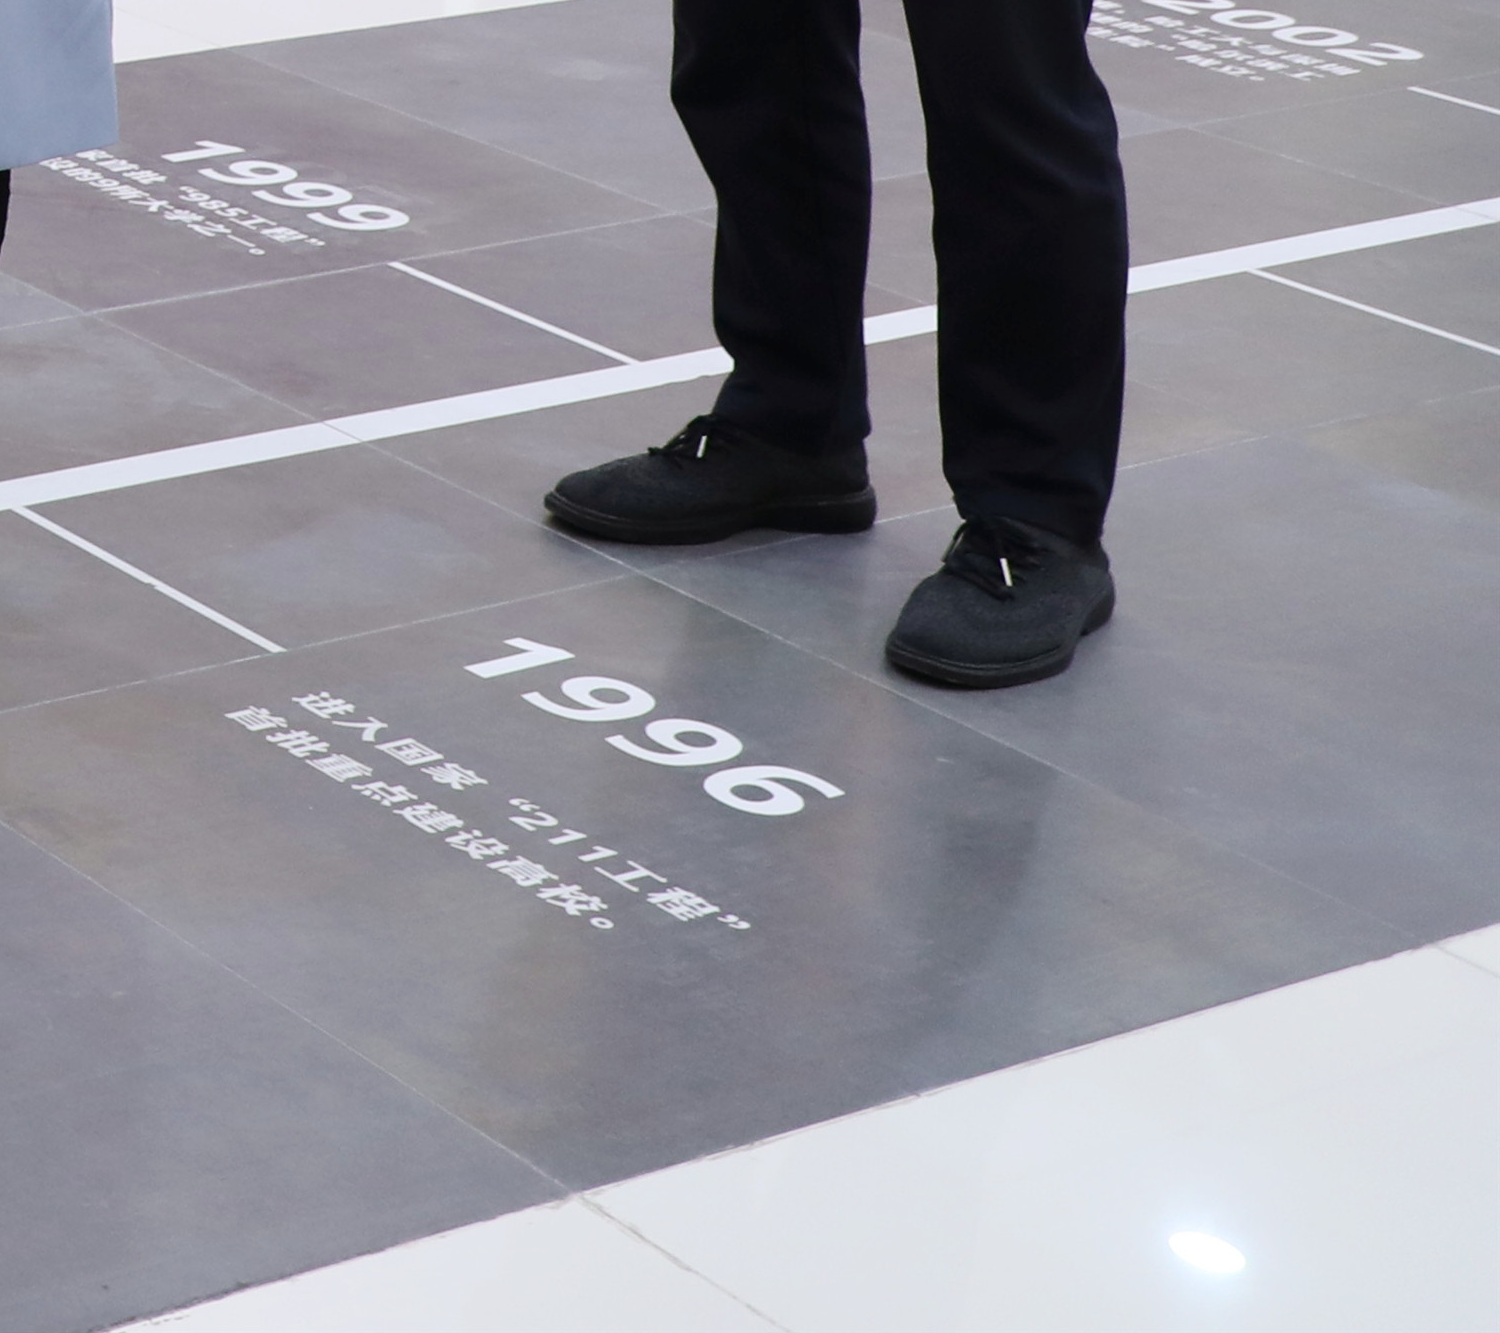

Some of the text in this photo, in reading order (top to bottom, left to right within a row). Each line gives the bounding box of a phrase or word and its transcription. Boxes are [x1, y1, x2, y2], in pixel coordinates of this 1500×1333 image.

[161, 140, 410, 231] 1999
[464, 637, 845, 816] 1996
[225, 705, 615, 930] 首批重点建设高校。
